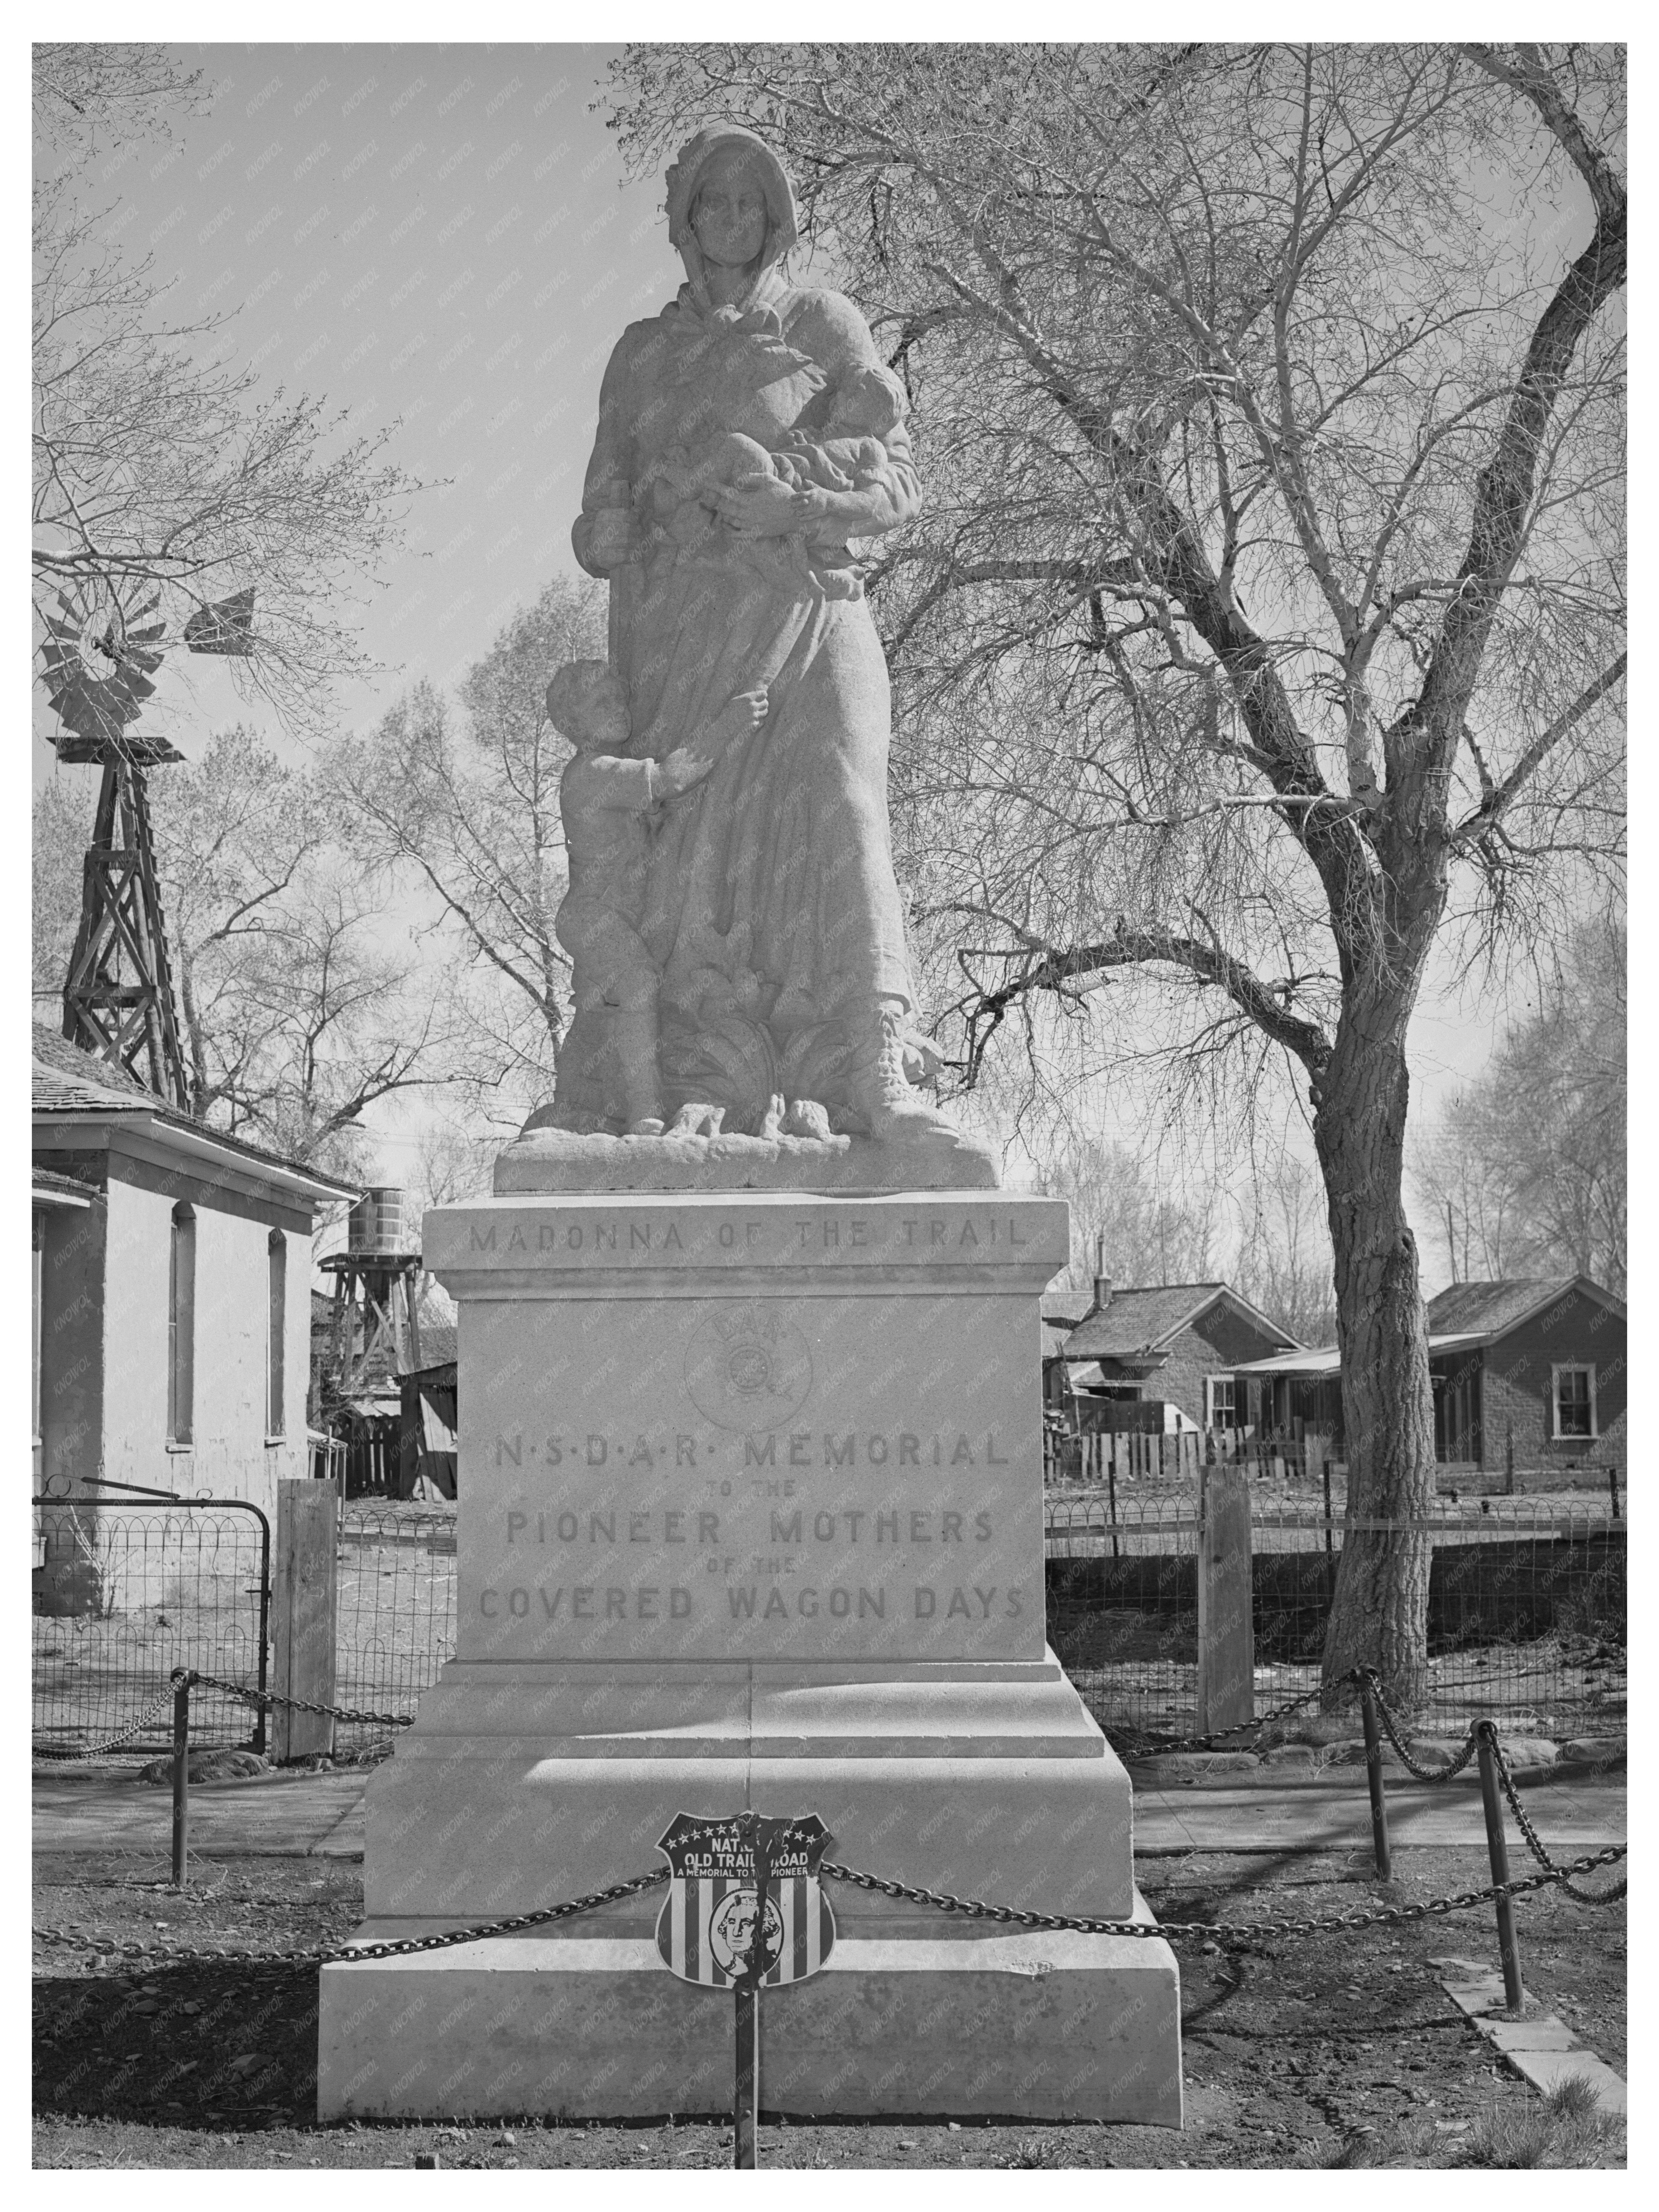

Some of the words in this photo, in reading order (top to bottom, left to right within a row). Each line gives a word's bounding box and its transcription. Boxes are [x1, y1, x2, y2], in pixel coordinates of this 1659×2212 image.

[470, 1223, 684, 1251] MADONNA
[719, 1222, 762, 1248] OF
[795, 1221, 867, 1247] THE
[903, 1219, 1026, 1246] TRAIL
[744, 1433, 1008, 1465] MEMORIAL
[706, 1480, 731, 1496] TO
[751, 1479, 795, 1497] THE
[508, 1511, 719, 1543] PIONEER
[770, 1511, 992, 1542] MOTHERS
[708, 1557, 735, 1573] OF
[756, 1556, 796, 1573] THE
[480, 1587, 692, 1619] COVERED
[728, 1587, 885, 1619] WAGON
[915, 1587, 1022, 1618] DAYS
[677, 1868, 684, 1876] A
[687, 1868, 734, 1877] MEMORIAL
[736, 1869, 749, 1877] TO
[685, 1853, 712, 1867] OLD
